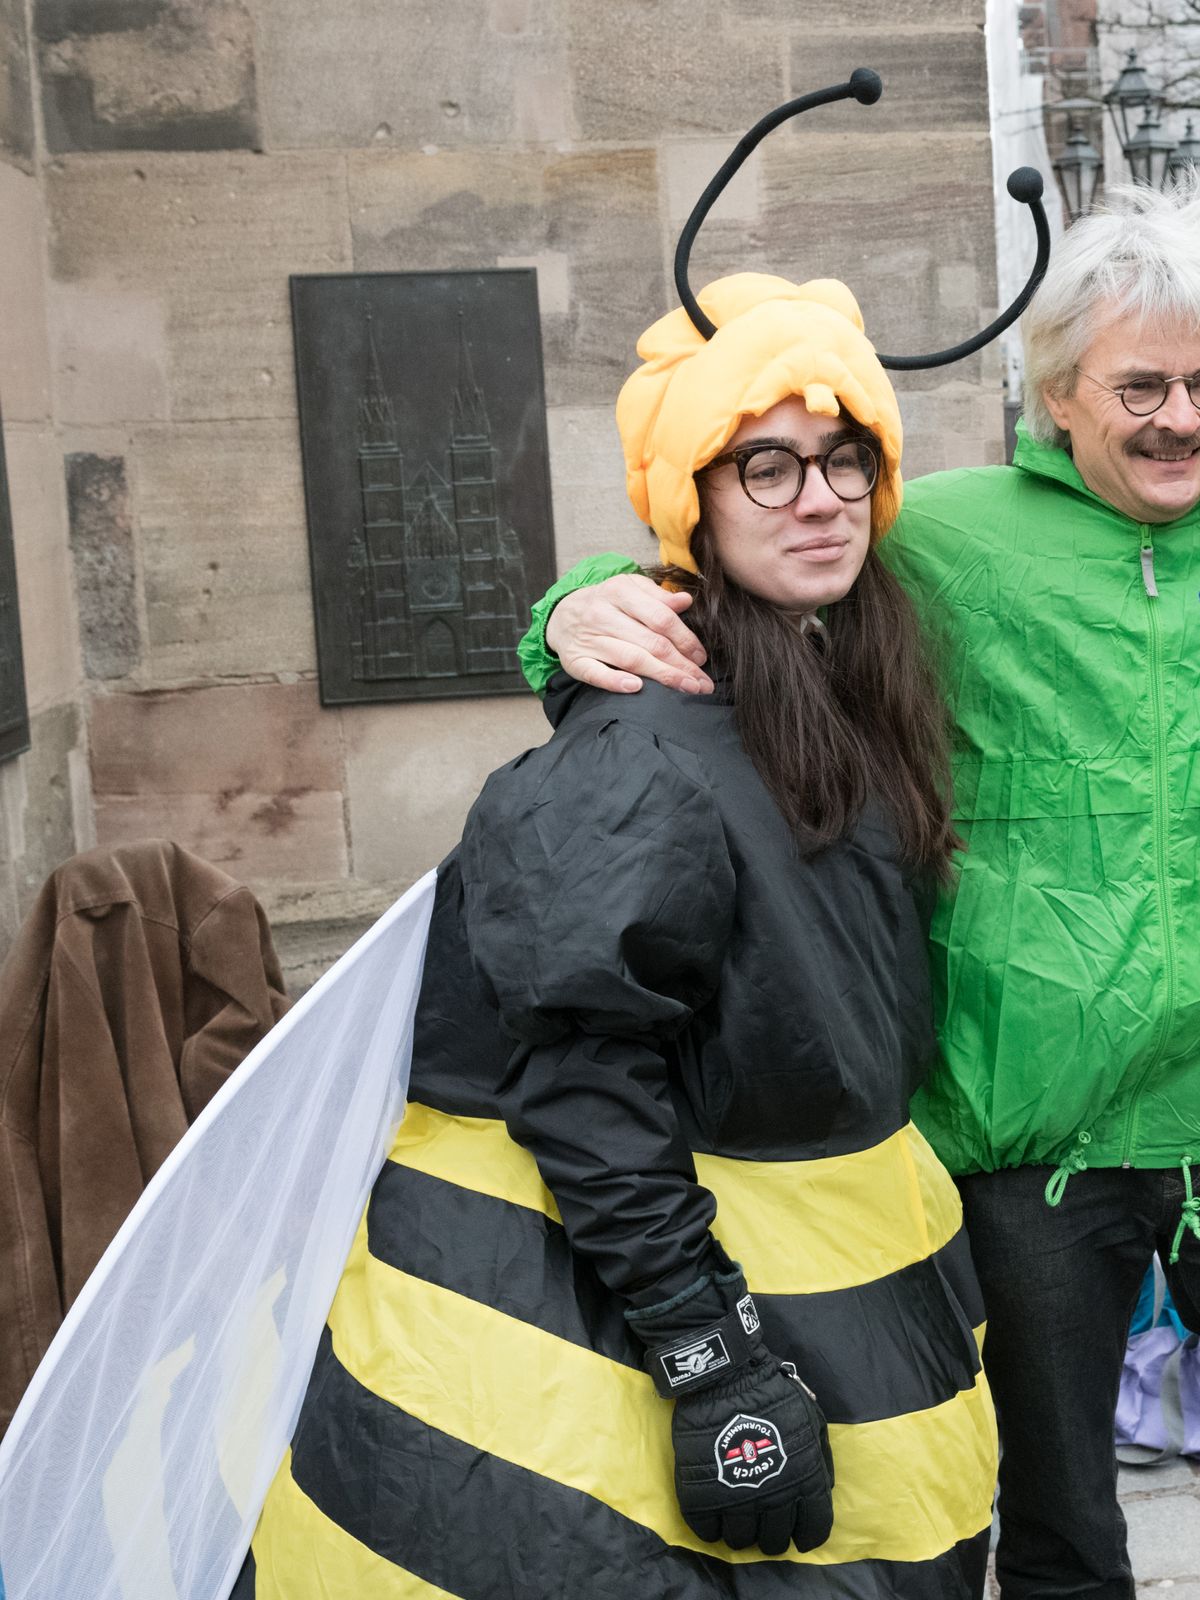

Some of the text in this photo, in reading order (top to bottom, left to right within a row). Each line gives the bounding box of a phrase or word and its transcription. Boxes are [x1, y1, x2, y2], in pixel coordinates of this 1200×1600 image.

[672, 1371, 692, 1383] reusch
[721, 1422, 771, 1450] TOURNAMENT
[733, 1457, 774, 1478] reusch
